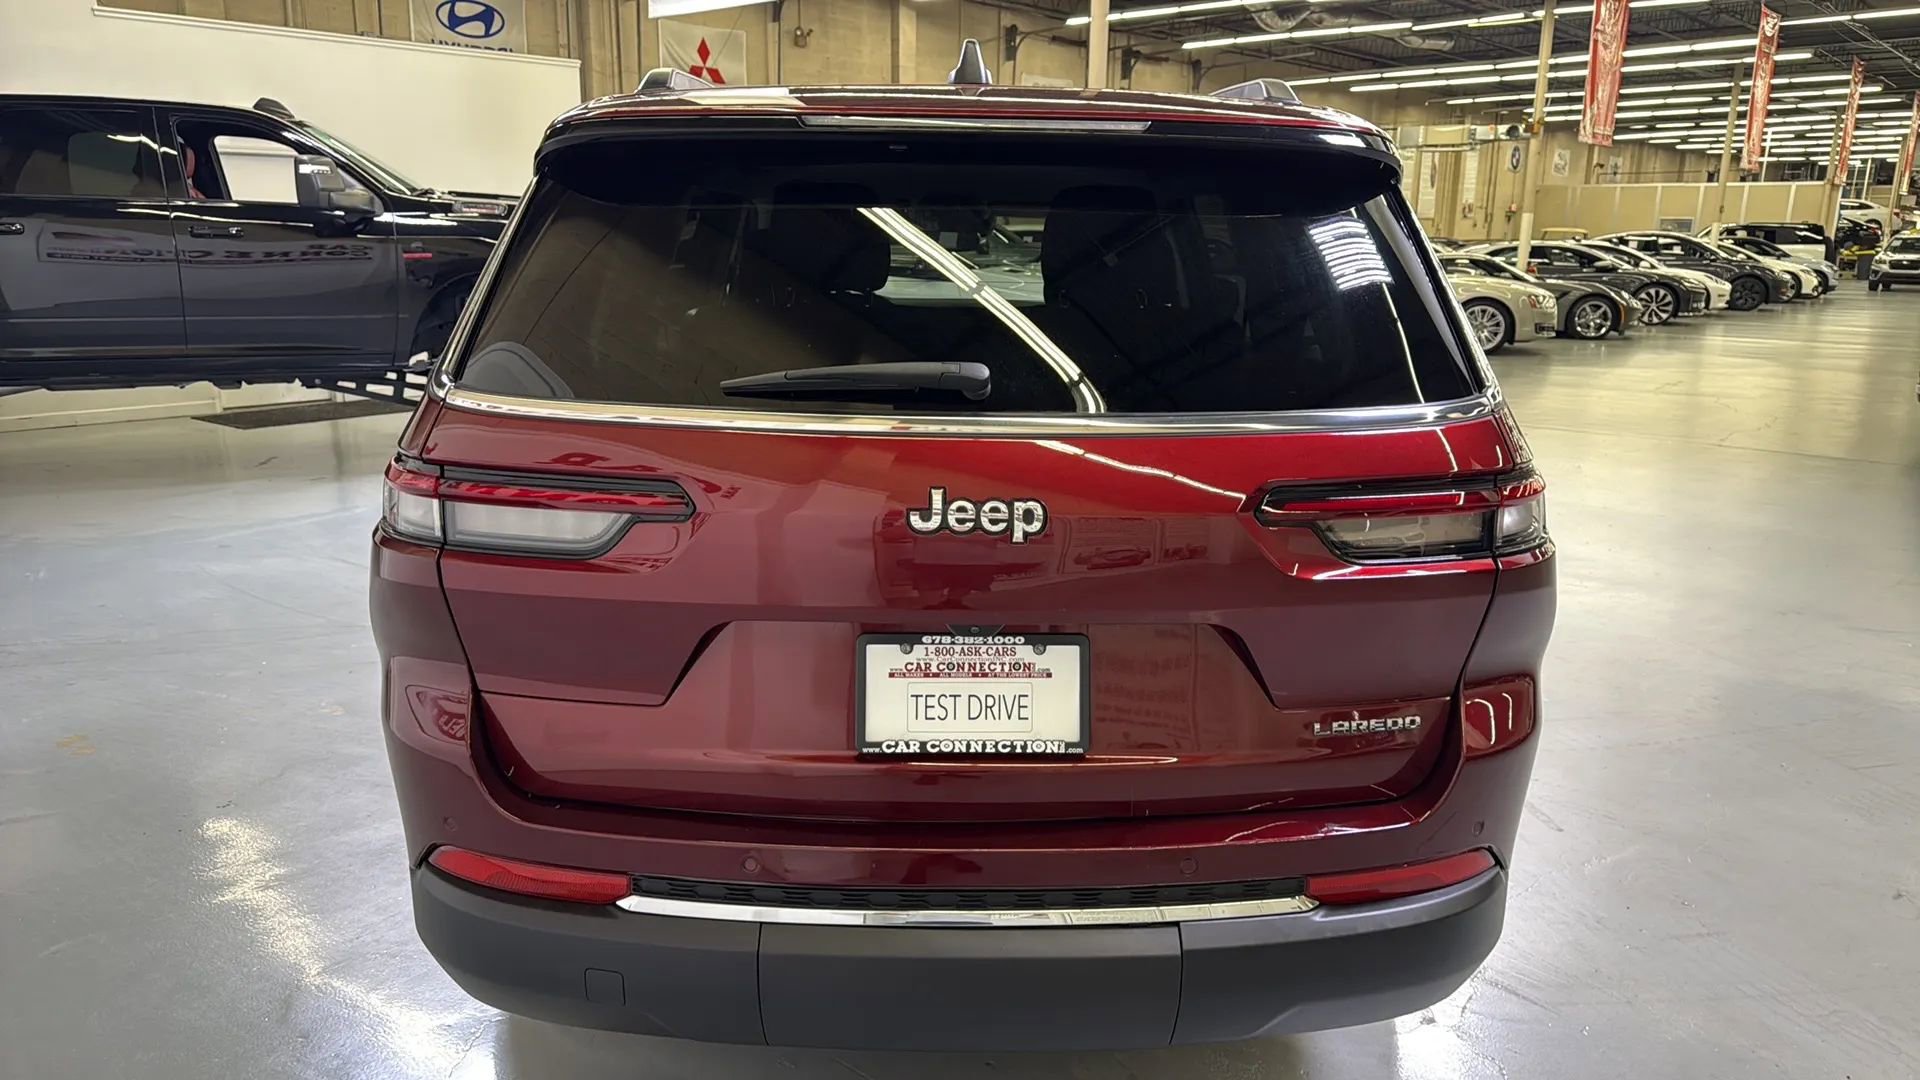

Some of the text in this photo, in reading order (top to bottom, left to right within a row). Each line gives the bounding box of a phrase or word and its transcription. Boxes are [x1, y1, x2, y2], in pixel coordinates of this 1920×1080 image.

[909, 487, 1044, 543] Jeep
[921, 635, 1026, 645] 678-382-1000
[924, 646, 1017, 657] 1-800-ASK-CARS
[904, 662, 932, 672] CAR
[910, 694, 1029, 721] TEST DRIVE
[1313, 715, 1421, 736] LAREDO
[881, 740, 920, 753] CAR
